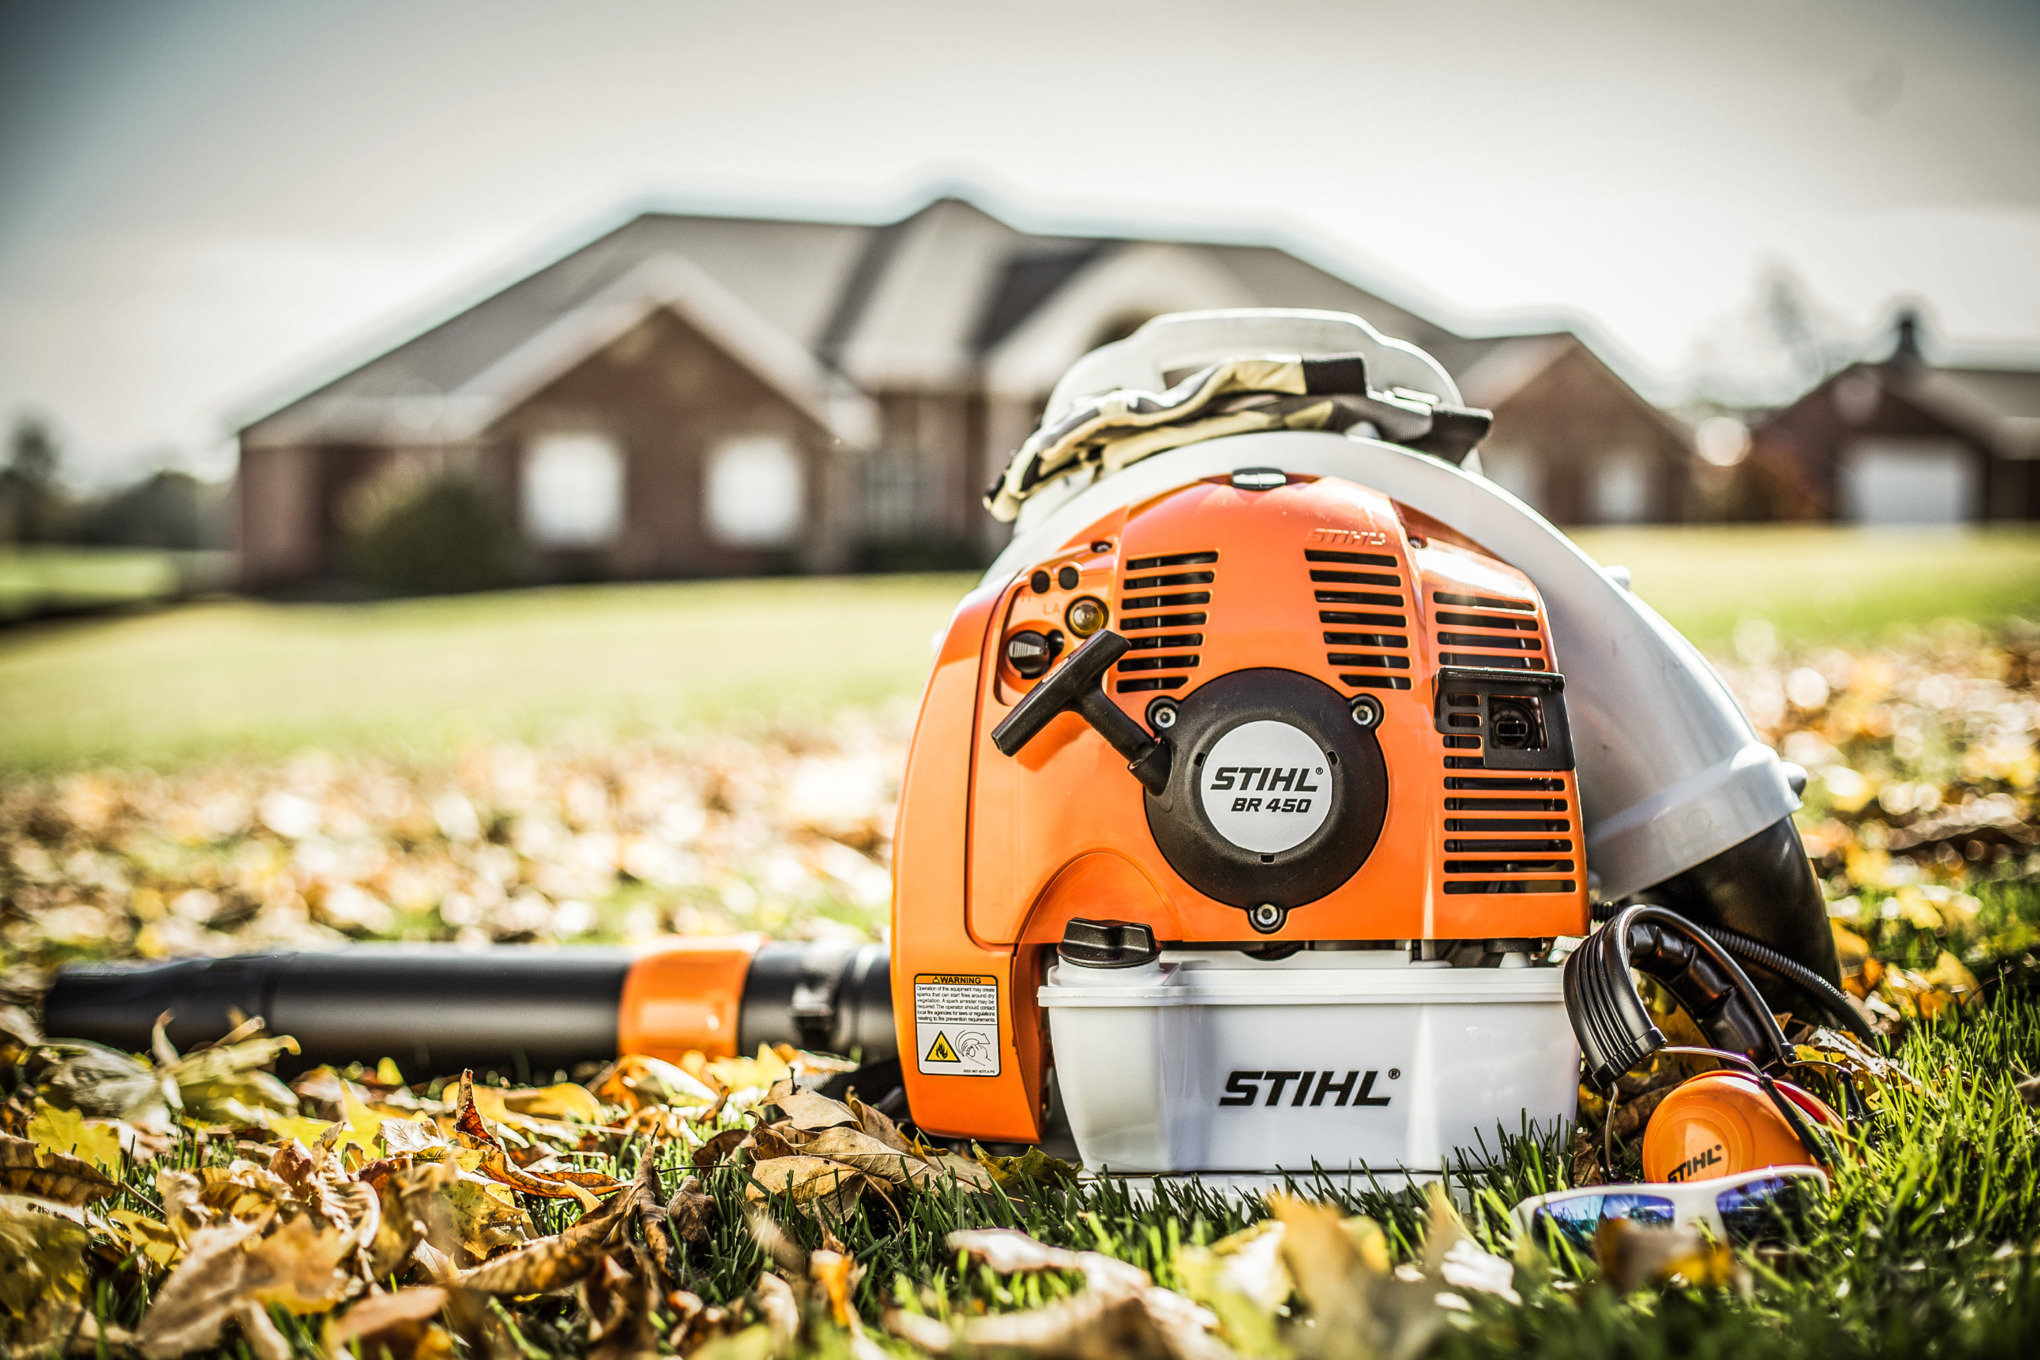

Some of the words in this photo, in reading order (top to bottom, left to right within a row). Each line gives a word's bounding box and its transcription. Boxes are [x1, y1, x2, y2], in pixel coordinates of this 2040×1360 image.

[1231, 798, 1262, 812] BR
[1265, 798, 1312, 813] 450
[940, 976, 982, 985] WARNING
